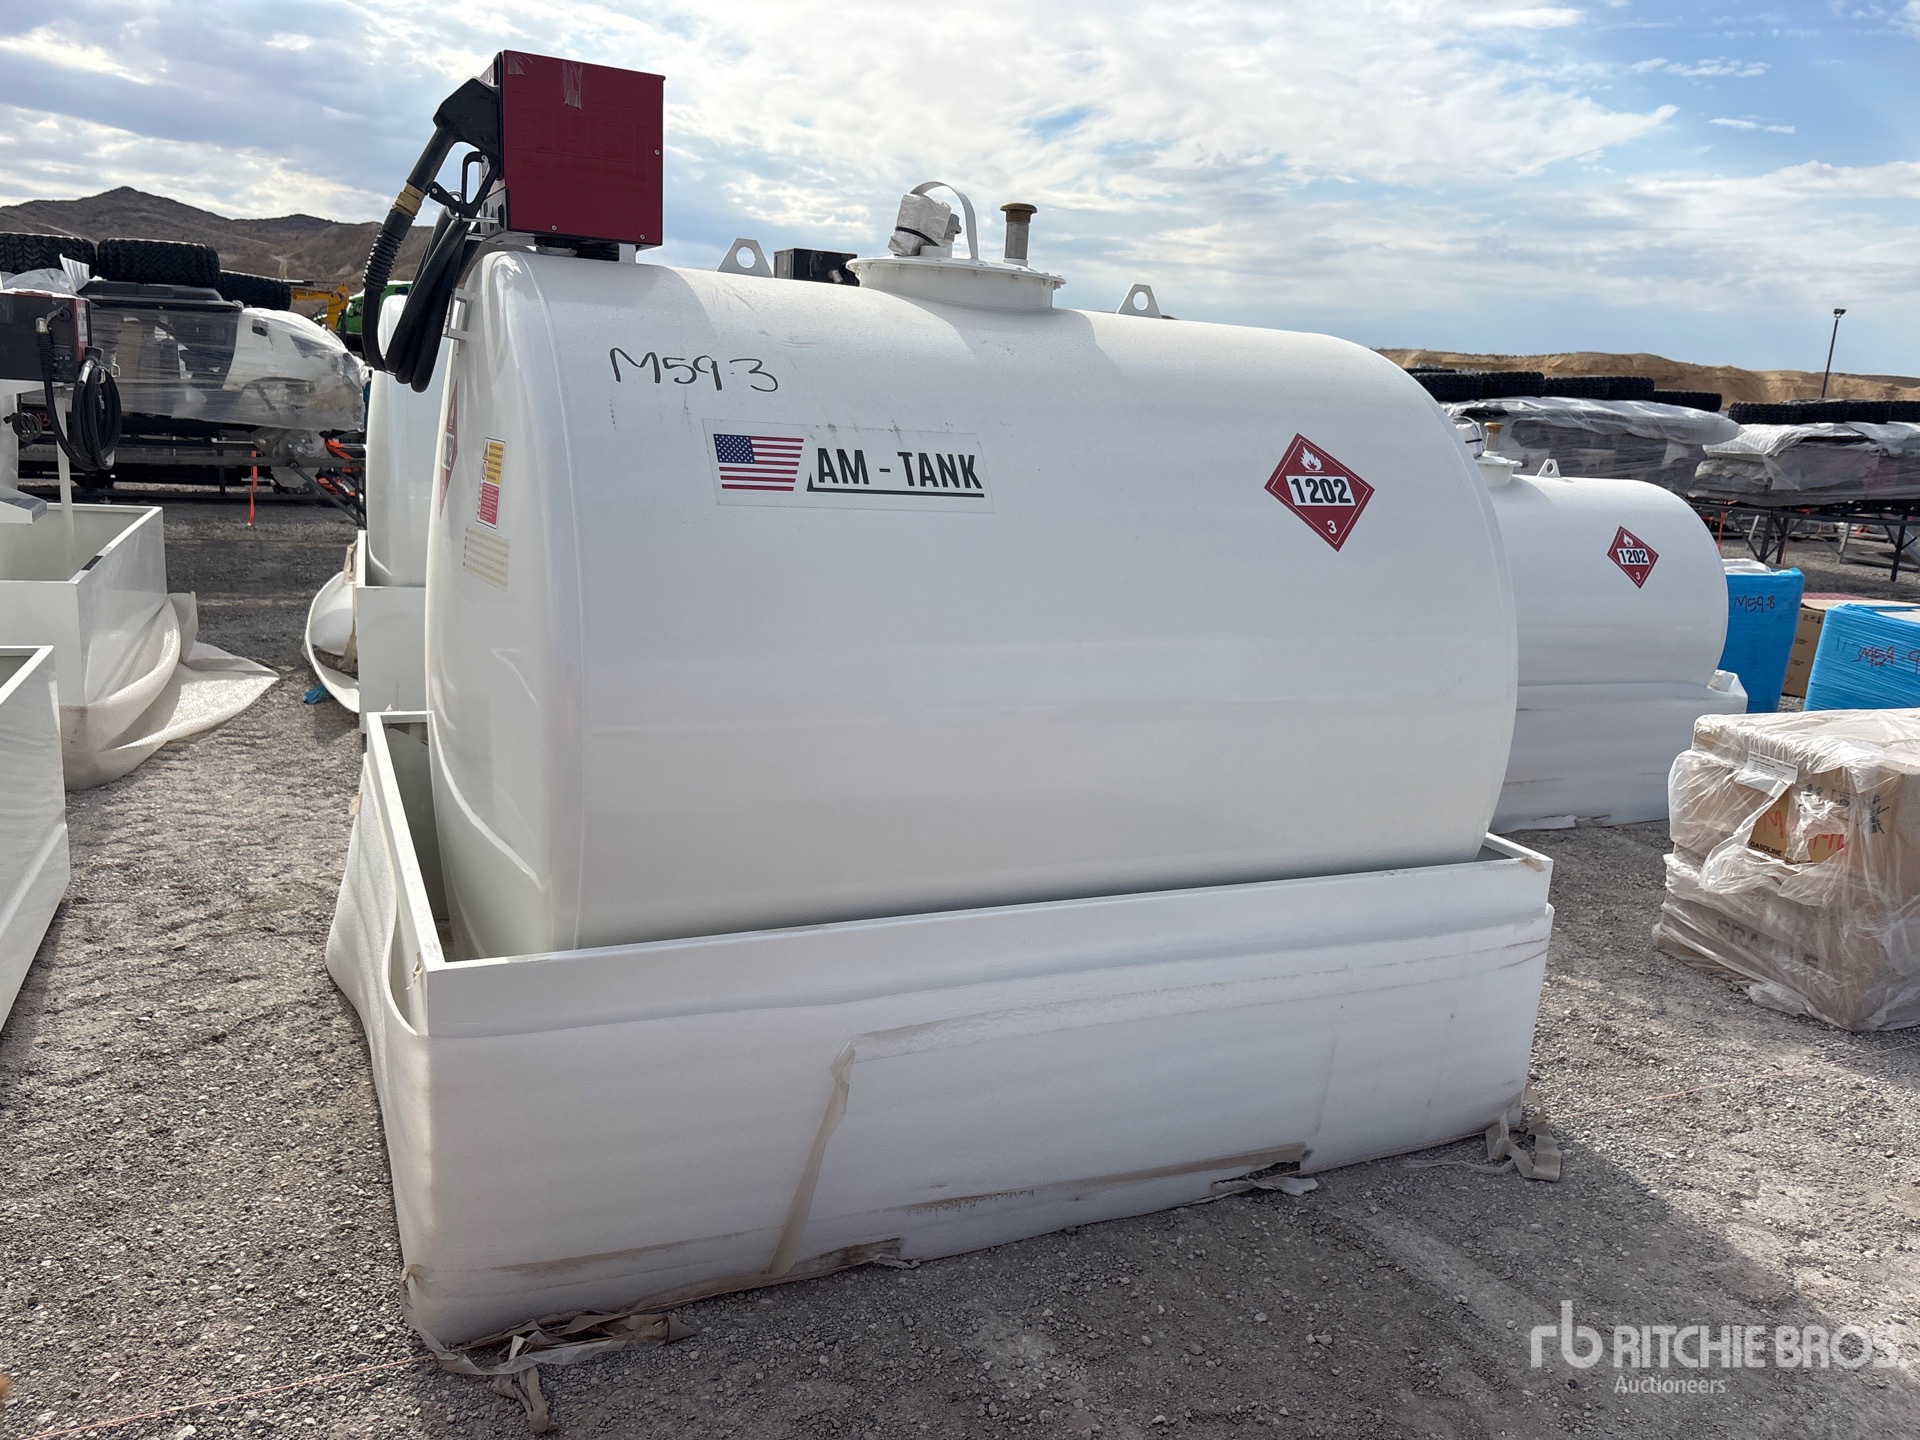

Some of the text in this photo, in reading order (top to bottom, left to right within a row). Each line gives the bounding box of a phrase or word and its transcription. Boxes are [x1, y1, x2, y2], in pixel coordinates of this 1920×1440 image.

[816, 447, 870, 485] AM
[897, 451, 983, 490] TANK
[1290, 478, 1353, 504] 1202
[1326, 519, 1338, 535] 3
[1619, 549, 1649, 564] 1202
[1635, 571, 1641, 581] 3
[1750, 840, 1782, 858] GASOLINE
